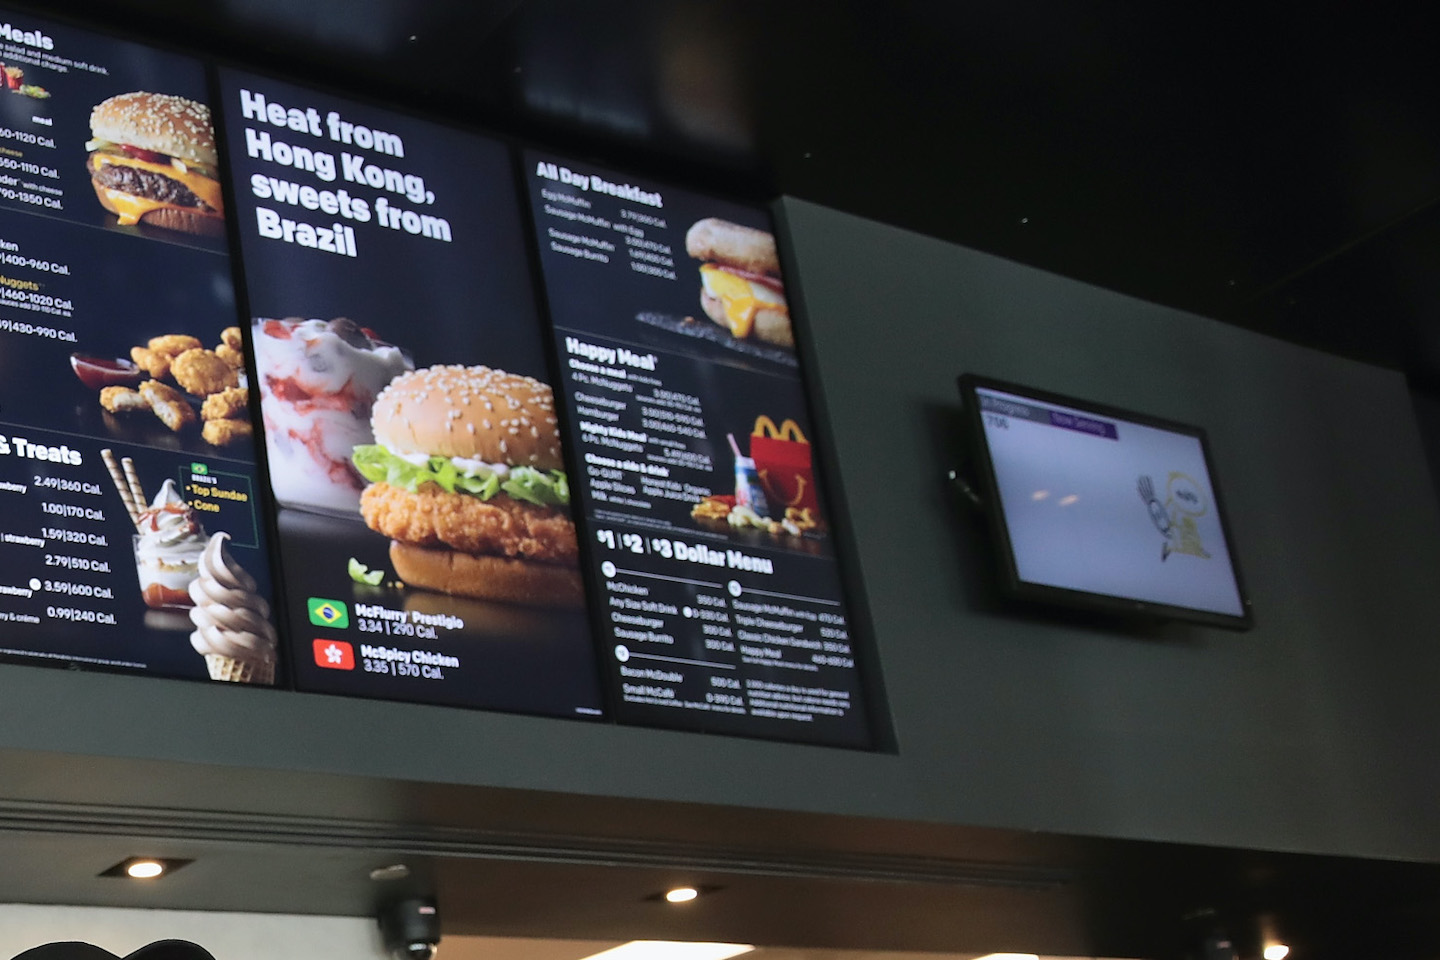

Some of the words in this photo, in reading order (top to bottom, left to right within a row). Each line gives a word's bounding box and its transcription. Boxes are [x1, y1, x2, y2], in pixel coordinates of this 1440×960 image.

[240, 89, 322, 136] Heat
[326, 112, 404, 157] from
[245, 128, 336, 181] Hong
[341, 152, 435, 204] Kong,
[537, 162, 559, 180] All
[559, 167, 589, 190] Day
[590, 175, 663, 208] Breakfast
[251, 174, 371, 222] sweets
[375, 197, 451, 242] from
[256, 206, 357, 257] Brazil
[565, 337, 616, 364] Happy
[617, 348, 655, 370] Meal
[12, 437, 82, 465] Treats
[34, 475, 81, 491] 2.49|360
[82, 483, 102, 494] Cal.
[191, 484, 210, 496] Top
[211, 487, 247, 501] Sundae
[194, 499, 219, 512] Cone
[597, 530, 615, 549] $1
[623, 534, 643, 553] $2
[652, 538, 673, 558] $3
[673, 541, 725, 566] Dollar
[726, 550, 773, 574] Menu
[360, 644, 411, 663] McSpicy
[411, 650, 459, 667] Chicken
